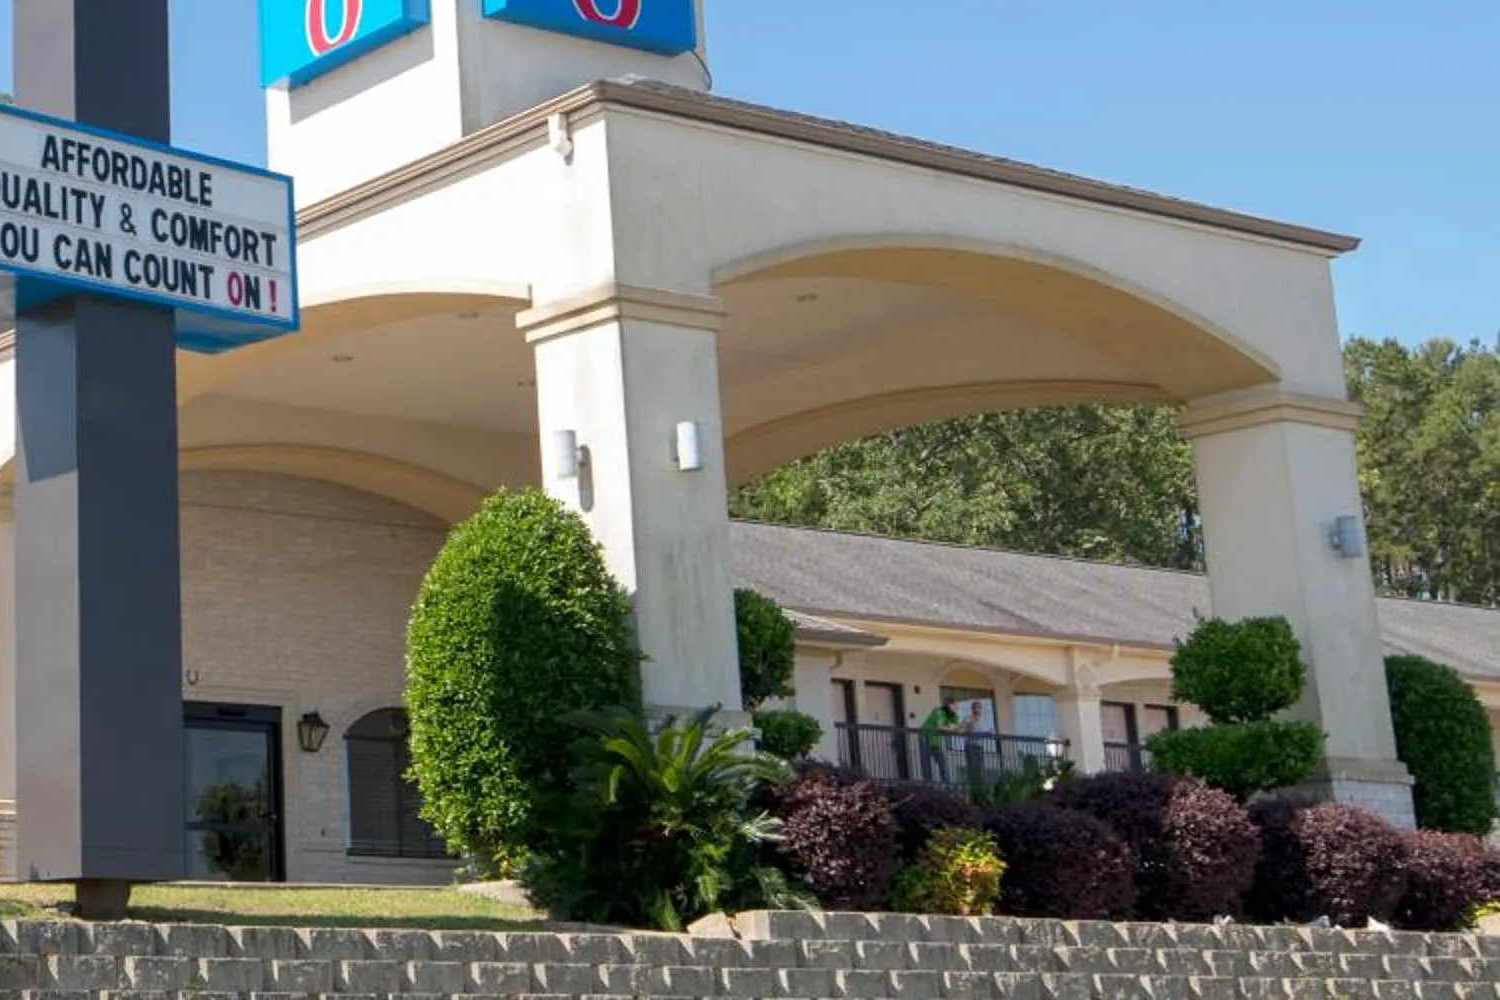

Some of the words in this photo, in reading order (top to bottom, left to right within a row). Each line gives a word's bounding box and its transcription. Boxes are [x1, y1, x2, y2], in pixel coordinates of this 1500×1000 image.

[40, 134, 213, 207] AFFORDABLE
[53, 233, 112, 279] CAN
[123, 250, 215, 299] COUNT
[119, 203, 137, 236] &
[150, 208, 277, 267] COMFORT
